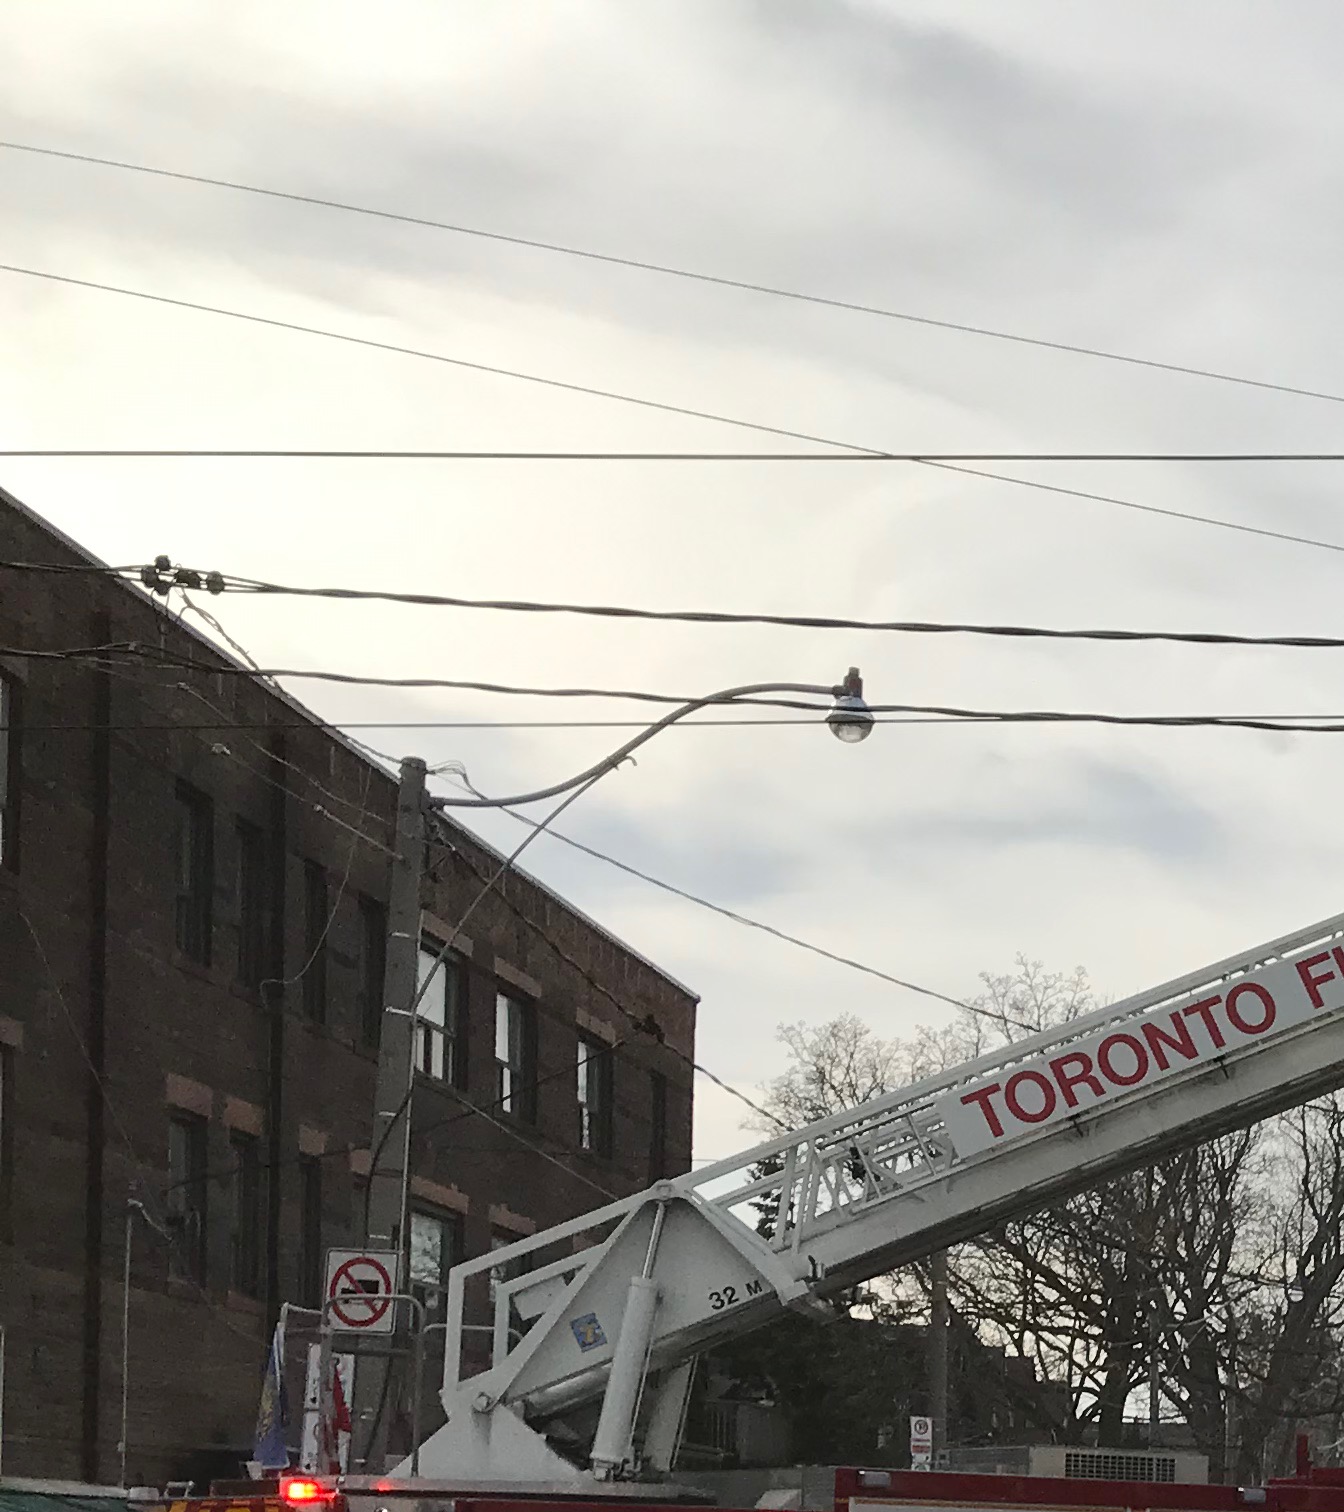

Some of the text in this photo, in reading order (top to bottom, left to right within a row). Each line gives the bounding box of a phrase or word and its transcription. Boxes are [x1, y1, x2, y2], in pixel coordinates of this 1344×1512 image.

[960, 981, 1277, 1138] TORONTO
[708, 1280, 763, 1310] 32 M
